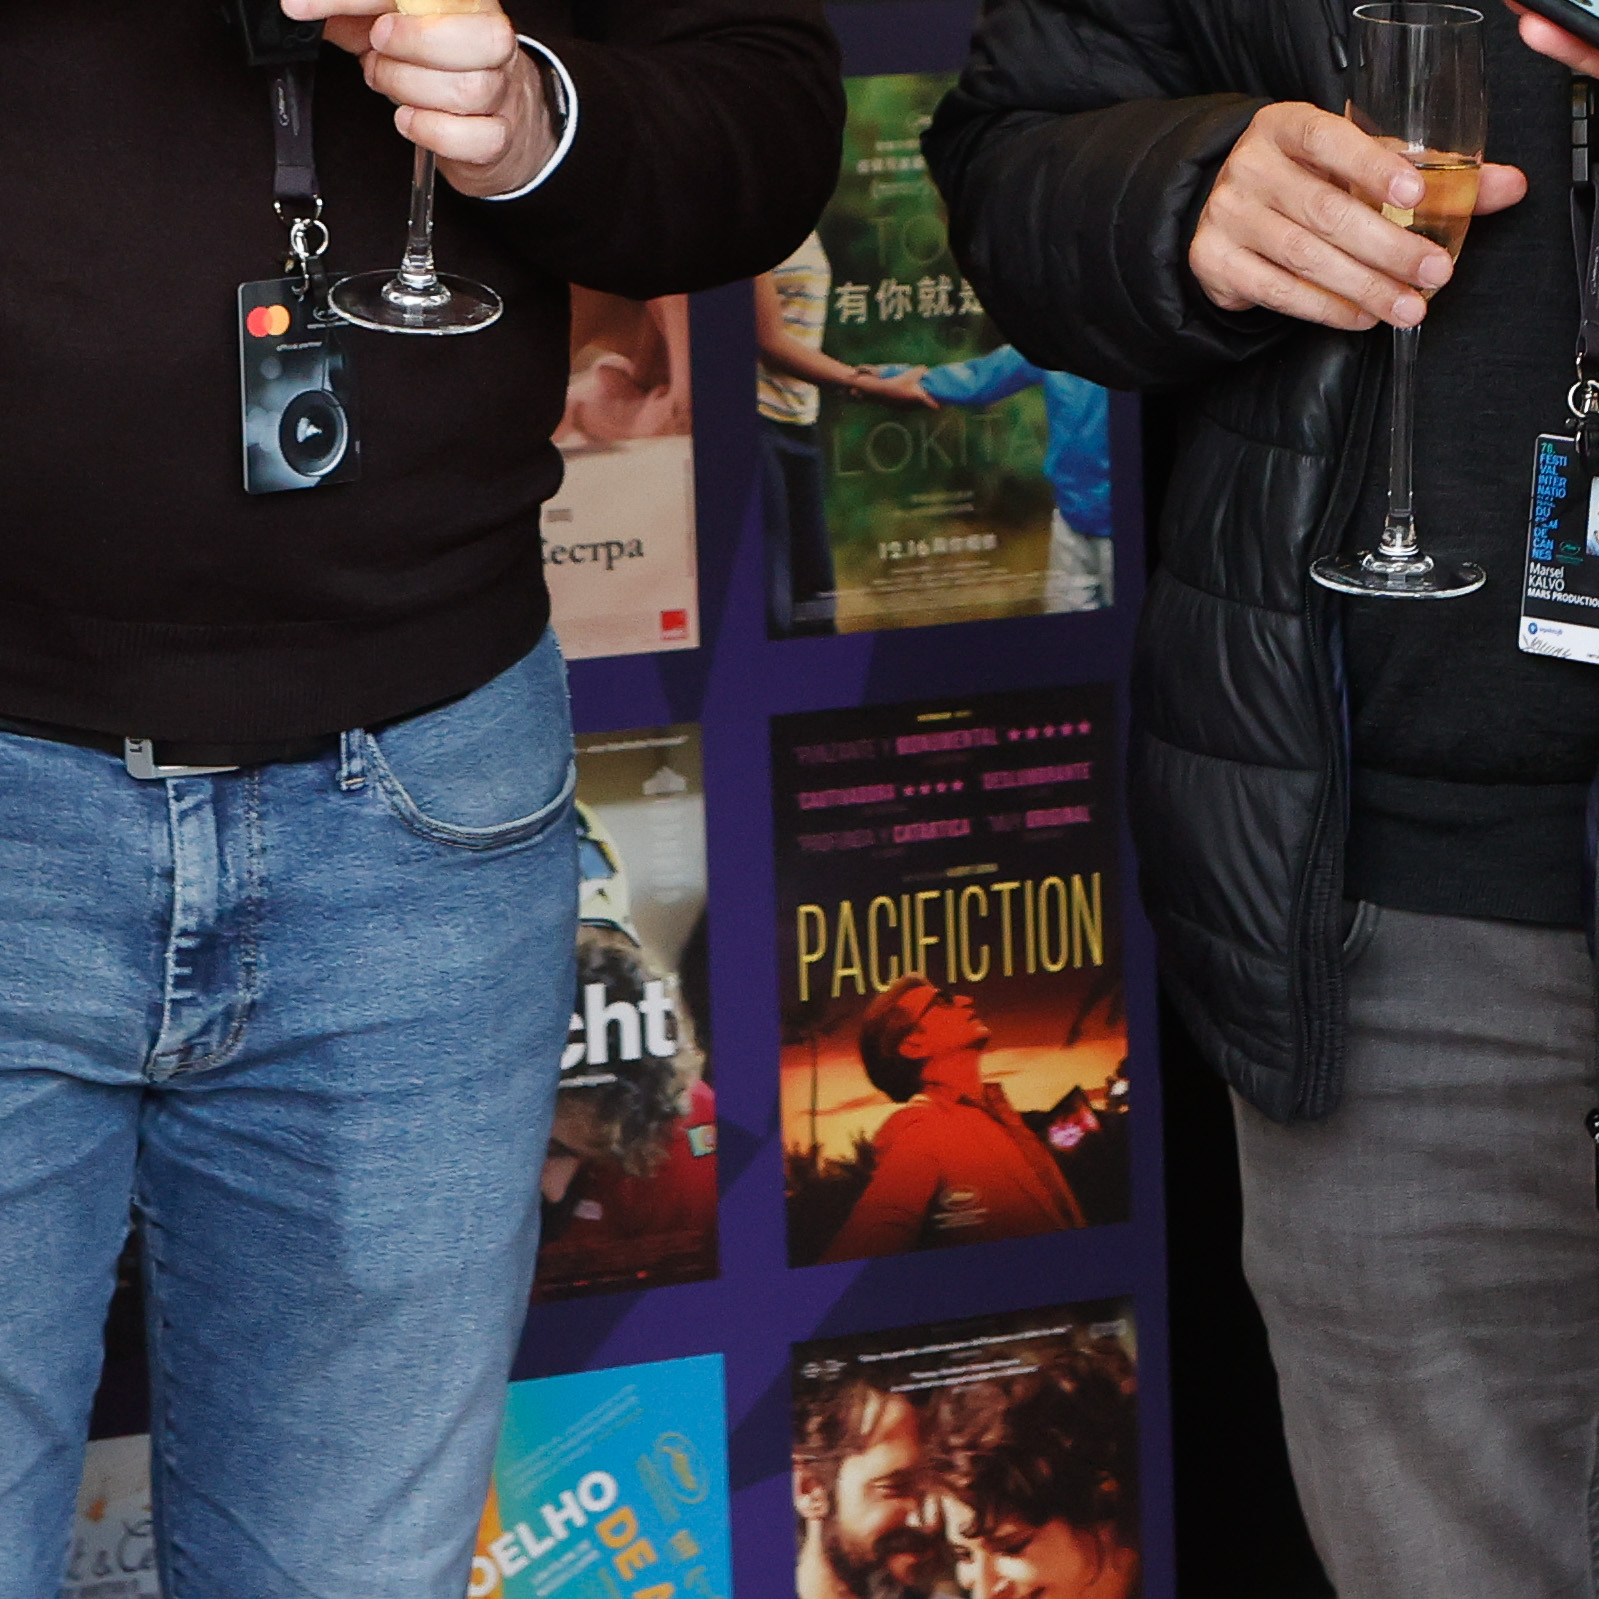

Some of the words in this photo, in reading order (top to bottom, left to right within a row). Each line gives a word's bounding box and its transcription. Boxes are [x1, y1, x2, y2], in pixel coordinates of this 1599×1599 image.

[832, 413, 1048, 479] LOKITA
[1539, 453, 1568, 467] FESTI
[1537, 485, 1567, 499] NATIO
[1535, 506, 1552, 518] DU
[1529, 561, 1565, 578] Marsel
[1528, 574, 1565, 591] KALVO
[1527, 587, 1551, 600] MARS
[796, 872, 1104, 1002] PACIFICTION
[595, 1506, 658, 1580] DE
